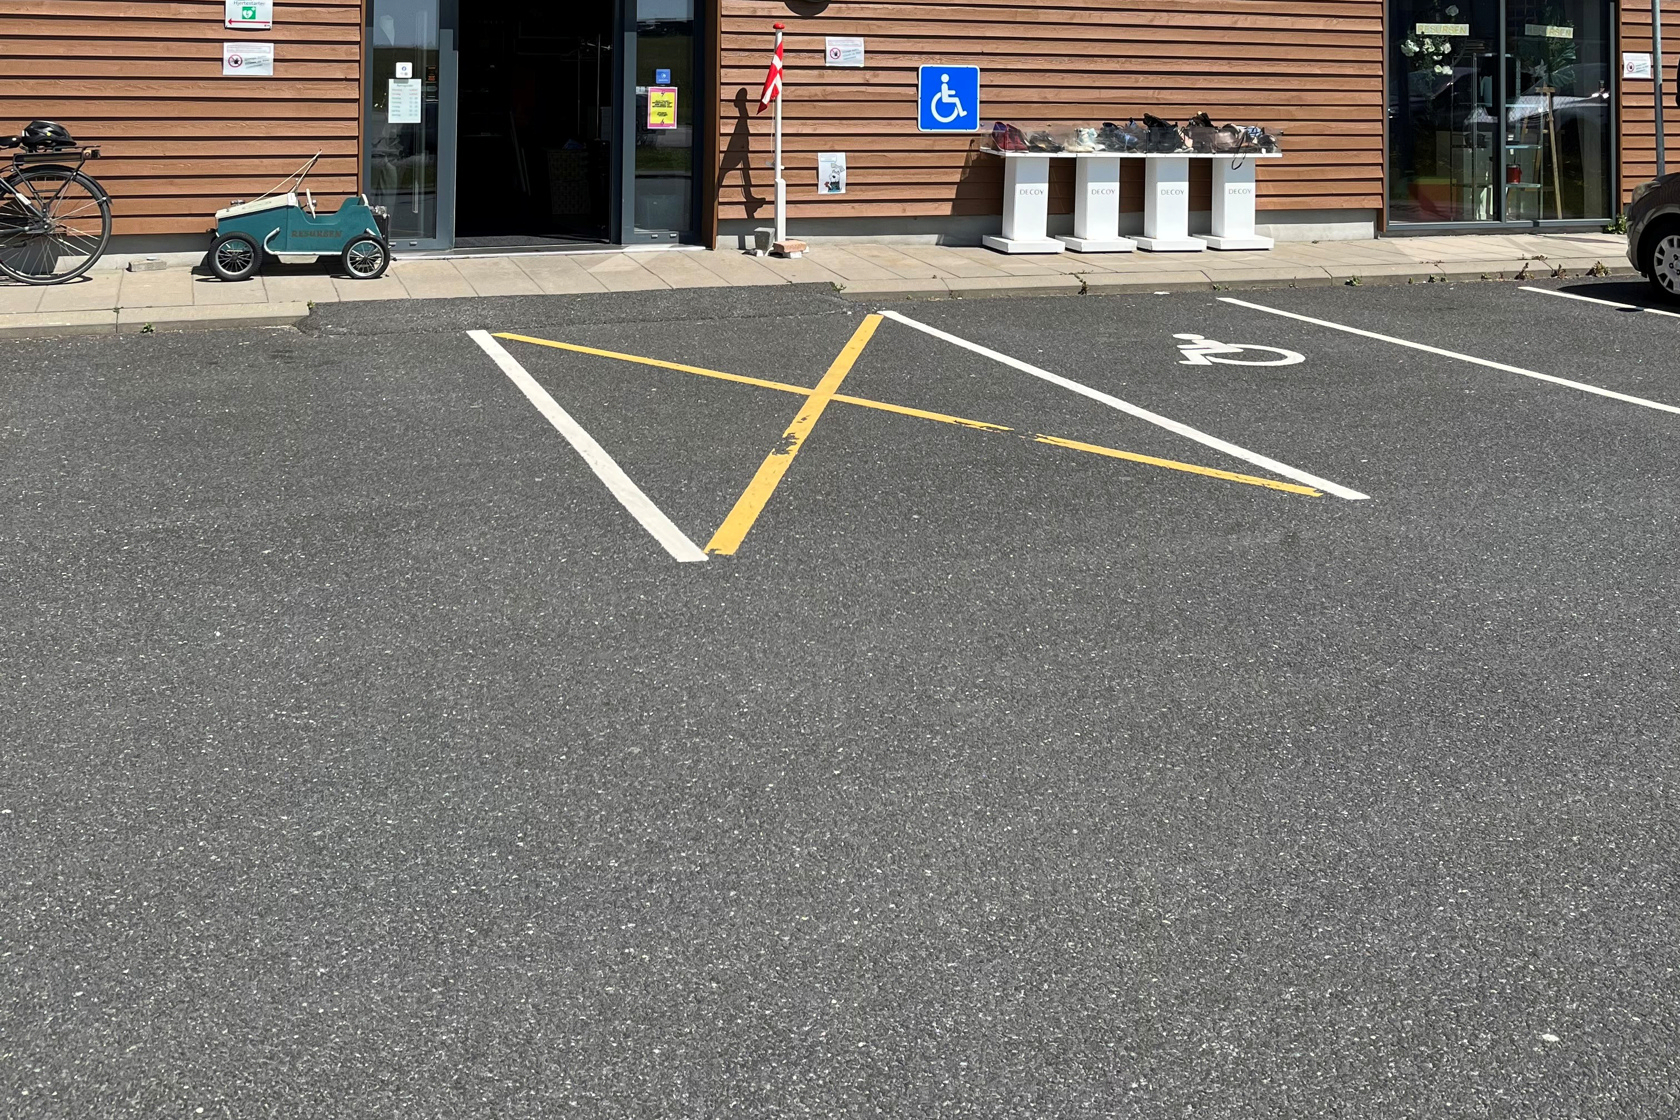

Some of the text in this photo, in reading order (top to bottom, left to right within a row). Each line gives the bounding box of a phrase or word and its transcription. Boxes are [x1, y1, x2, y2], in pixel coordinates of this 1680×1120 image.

[1417, 24, 1467, 34] RESURSEN
[1019, 188, 1044, 196] DECOY
[1091, 188, 1116, 196] DECOY
[1160, 188, 1185, 196] DECOY
[291, 230, 342, 238] RESURSEN
